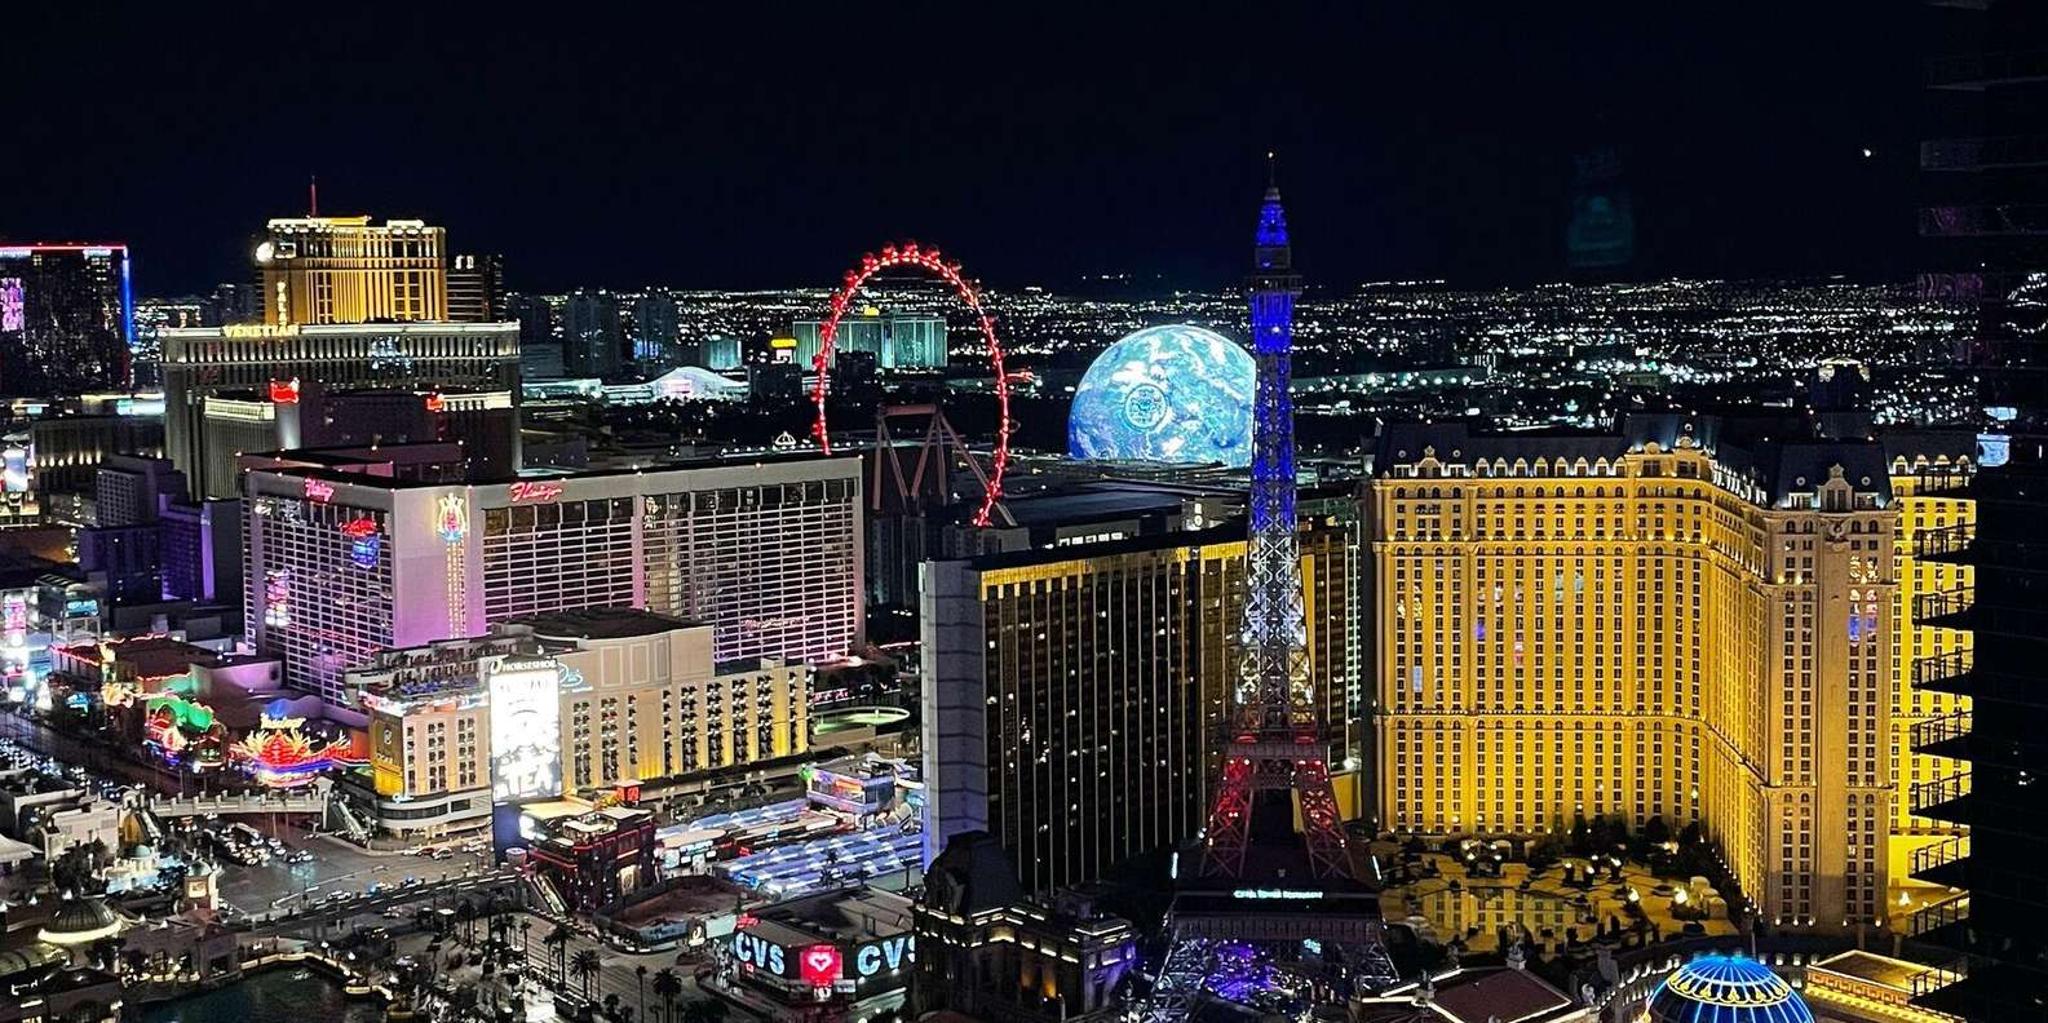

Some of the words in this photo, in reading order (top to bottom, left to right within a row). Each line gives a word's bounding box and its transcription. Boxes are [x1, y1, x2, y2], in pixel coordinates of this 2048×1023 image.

[222, 325, 299, 338] VENETIAN
[502, 660, 557, 672] HORSESHOE
[735, 931, 785, 975] CVS
